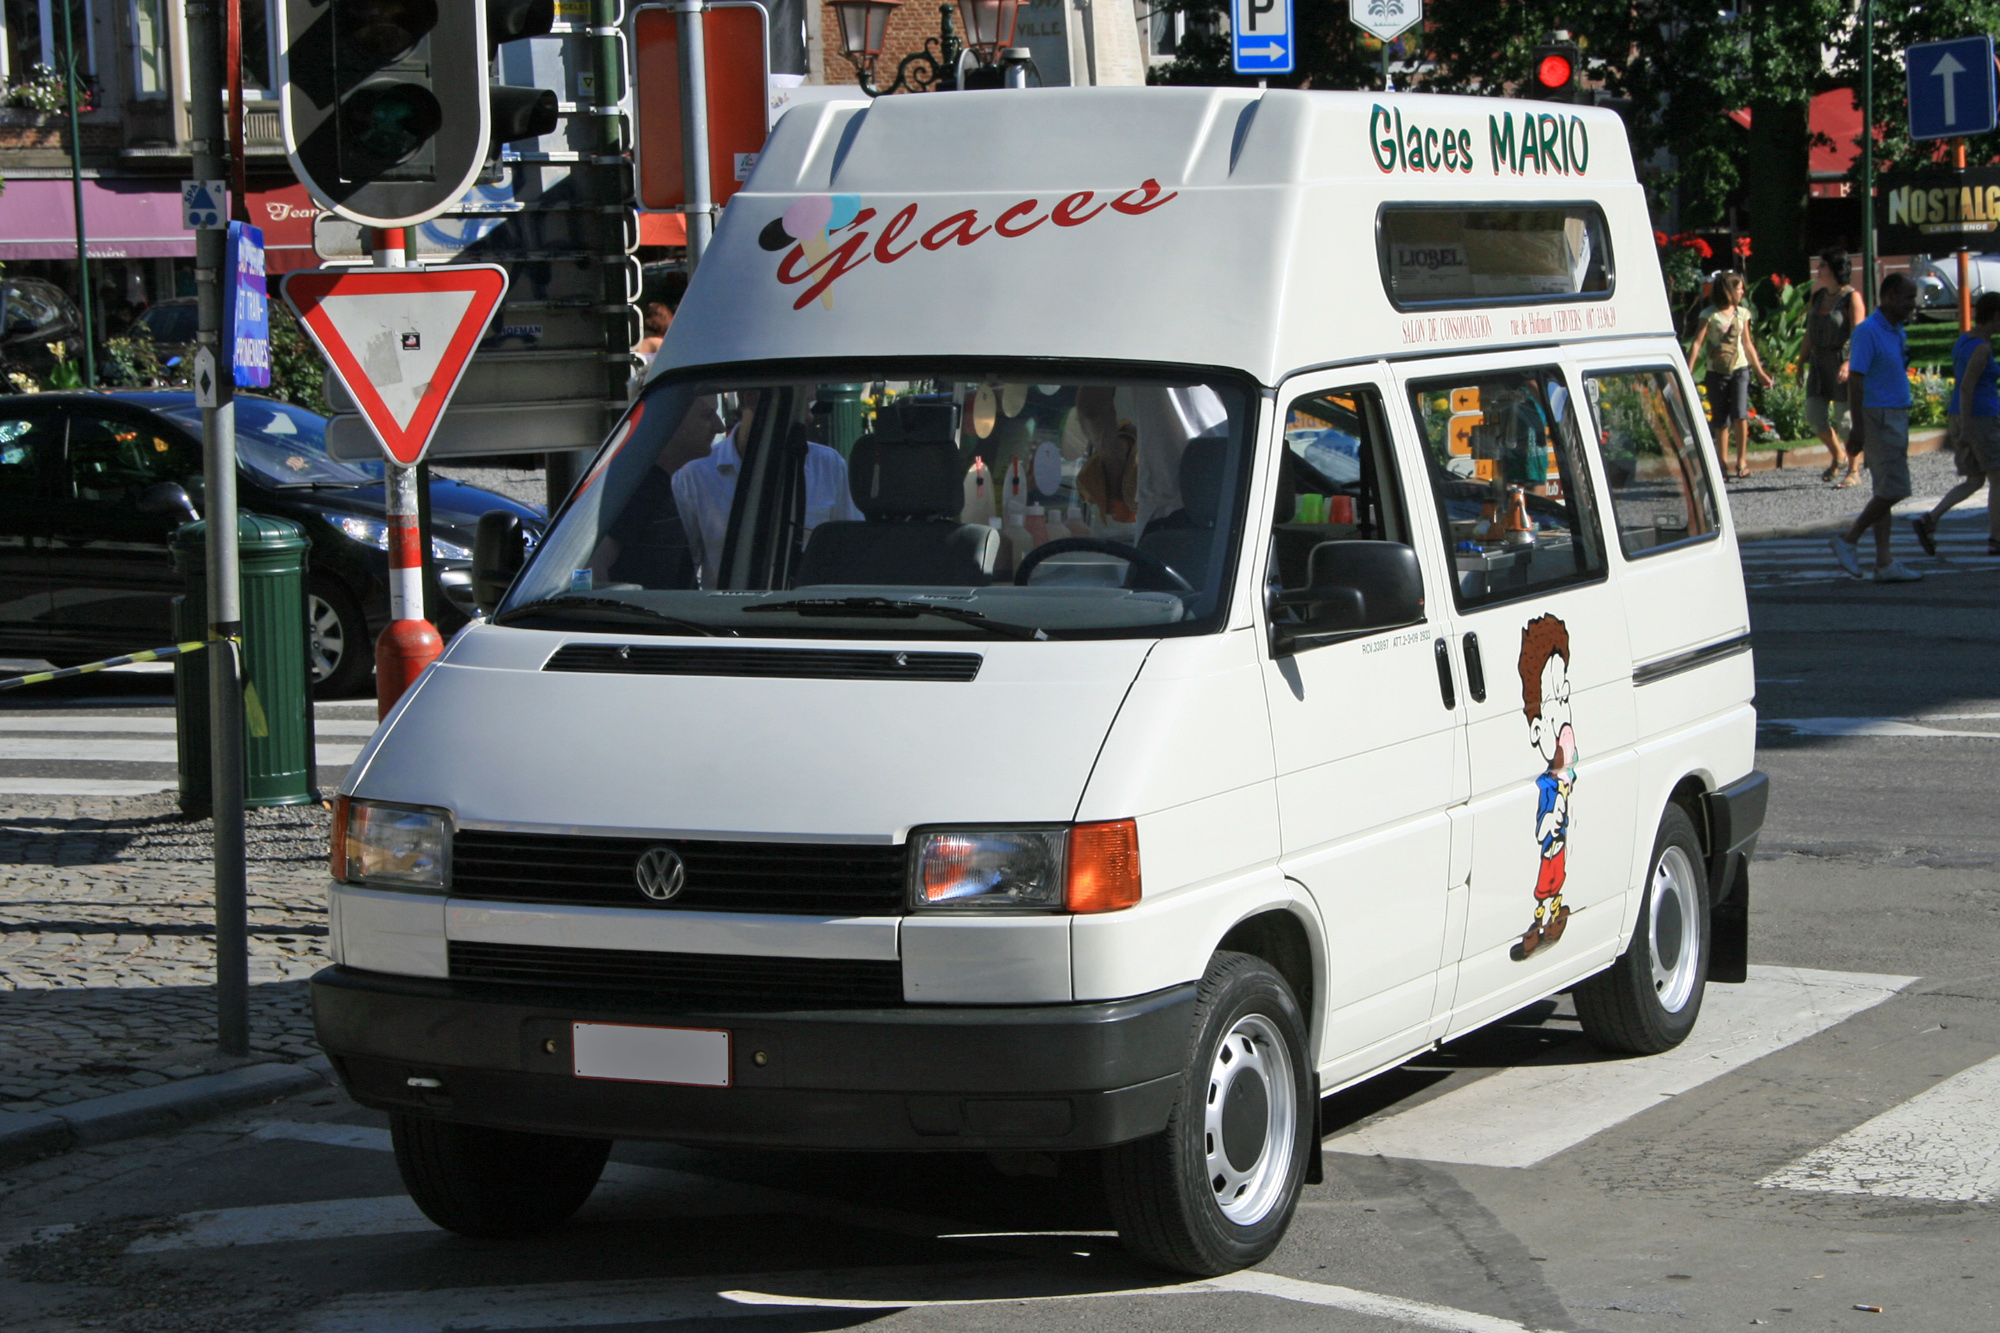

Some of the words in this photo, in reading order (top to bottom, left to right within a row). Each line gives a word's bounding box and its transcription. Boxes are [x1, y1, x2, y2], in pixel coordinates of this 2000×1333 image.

[1249, 0, 1275, 31] P
[1369, 103, 1474, 174] Glaces
[1488, 111, 1589, 177] MARIO
[184, 184, 198, 205] SPA
[1402, 319, 1426, 344] SALON
[1428, 318, 1438, 342] DE
[1439, 315, 1493, 341] CONSOMMATION
